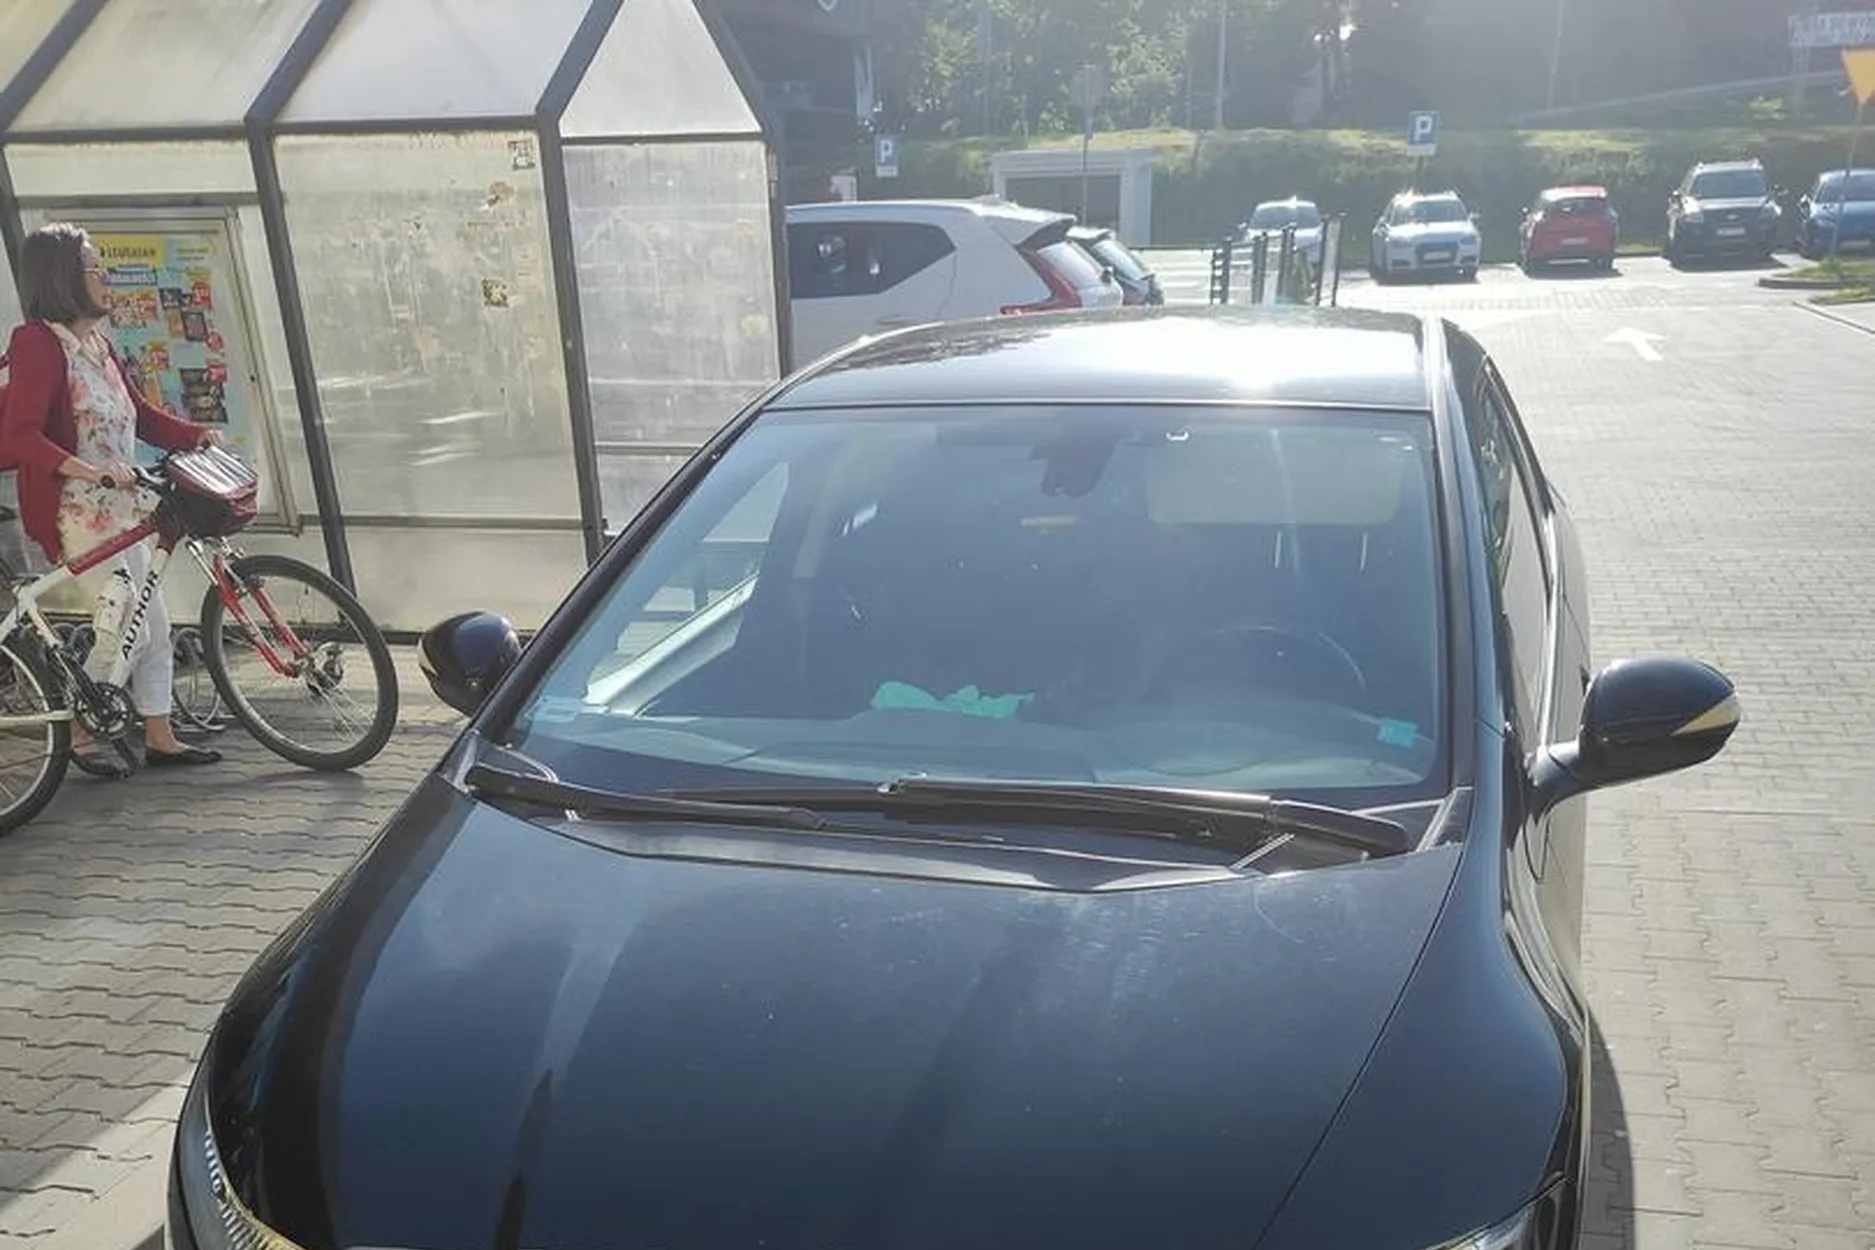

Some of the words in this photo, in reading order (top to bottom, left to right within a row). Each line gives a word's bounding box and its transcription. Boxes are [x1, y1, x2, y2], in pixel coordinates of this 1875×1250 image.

[1414, 116, 1433, 141] P
[880, 140, 893, 162] P
[121, 570, 158, 660] AUTHOR
